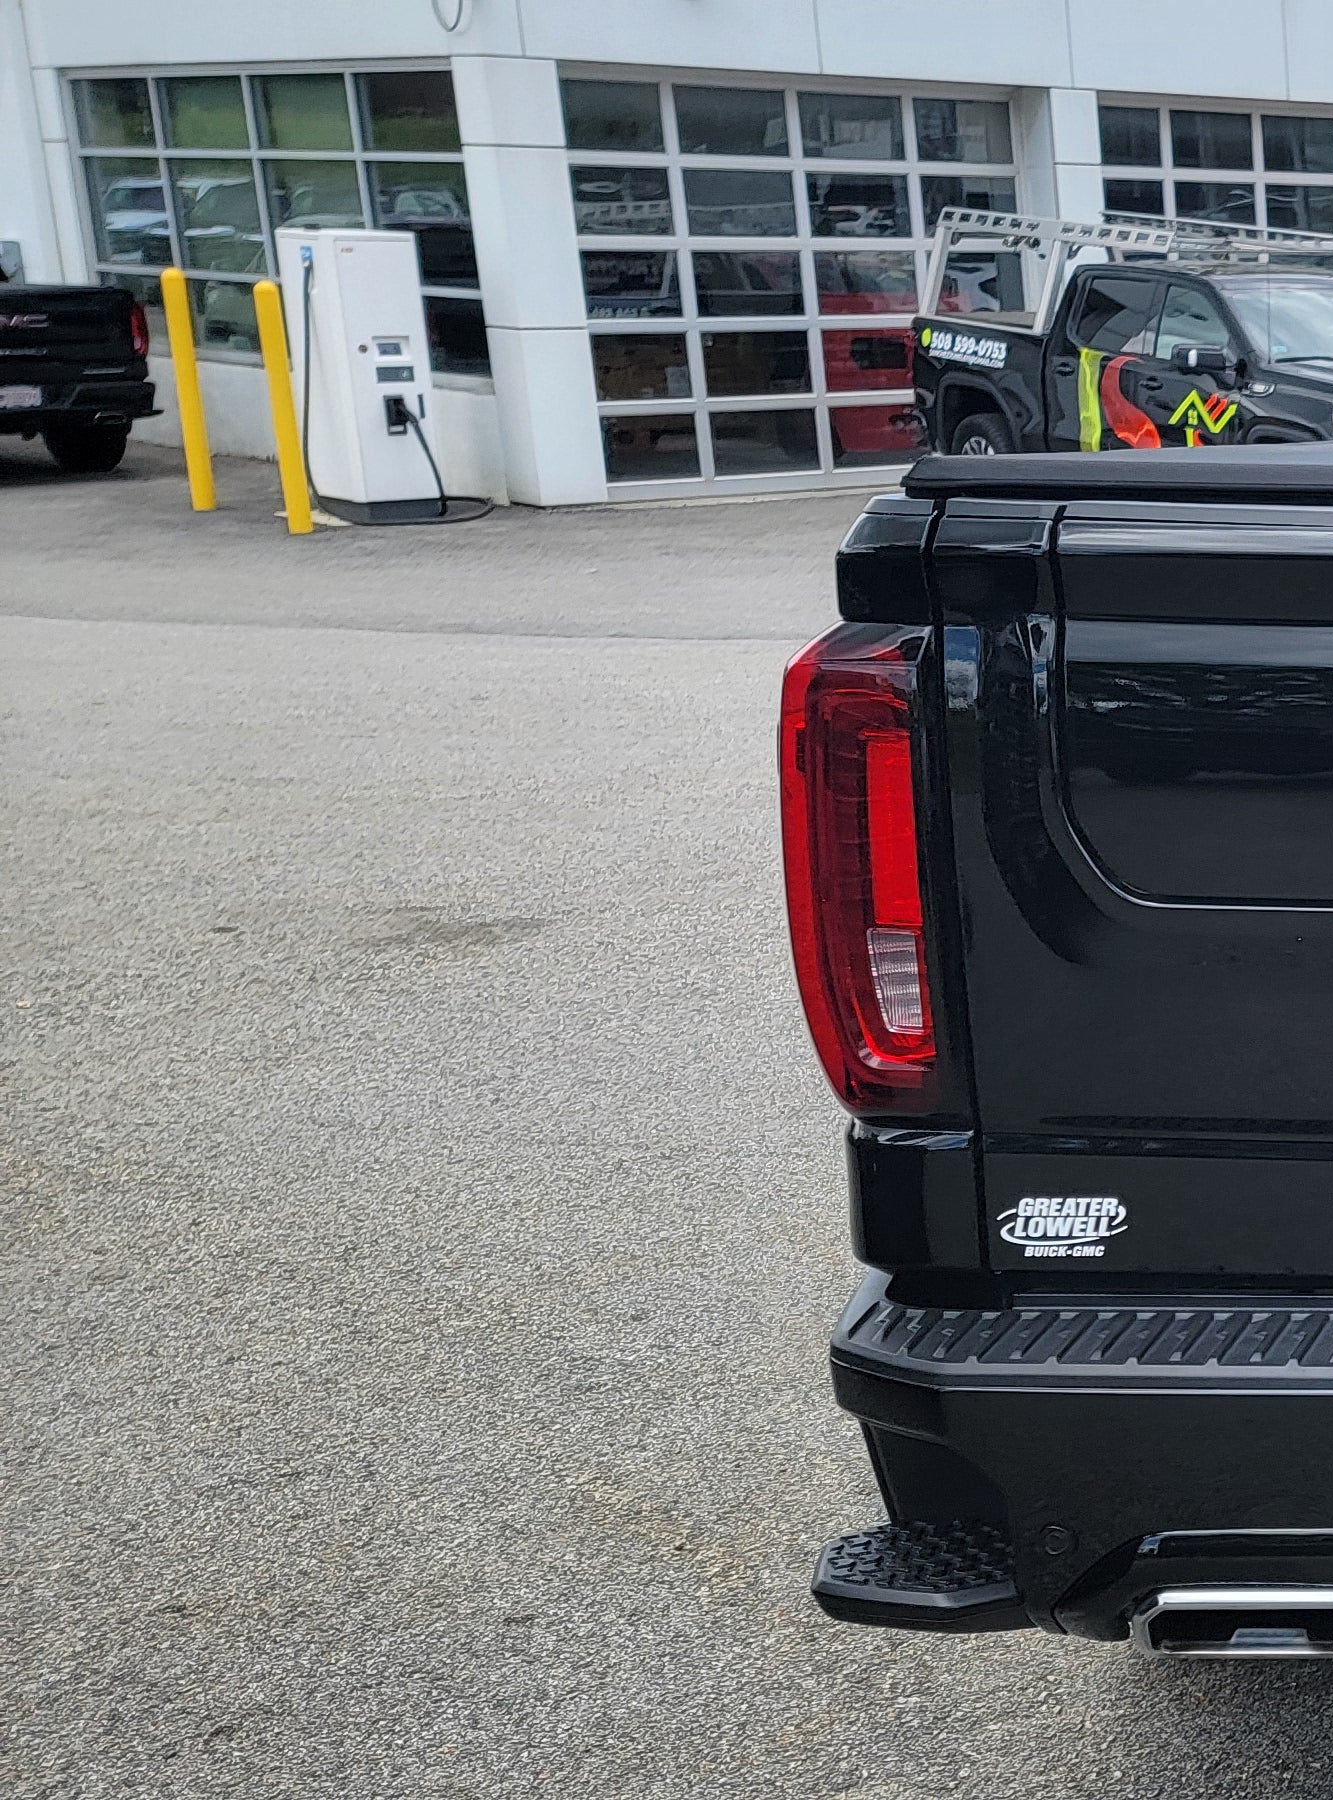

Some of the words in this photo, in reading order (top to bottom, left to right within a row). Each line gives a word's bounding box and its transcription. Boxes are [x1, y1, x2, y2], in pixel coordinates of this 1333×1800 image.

[929, 331, 953, 350] 508
[953, 334, 1008, 360] 599-0753
[1017, 1197, 1119, 1217] GREATER
[1014, 1217, 1111, 1237] LOWELL
